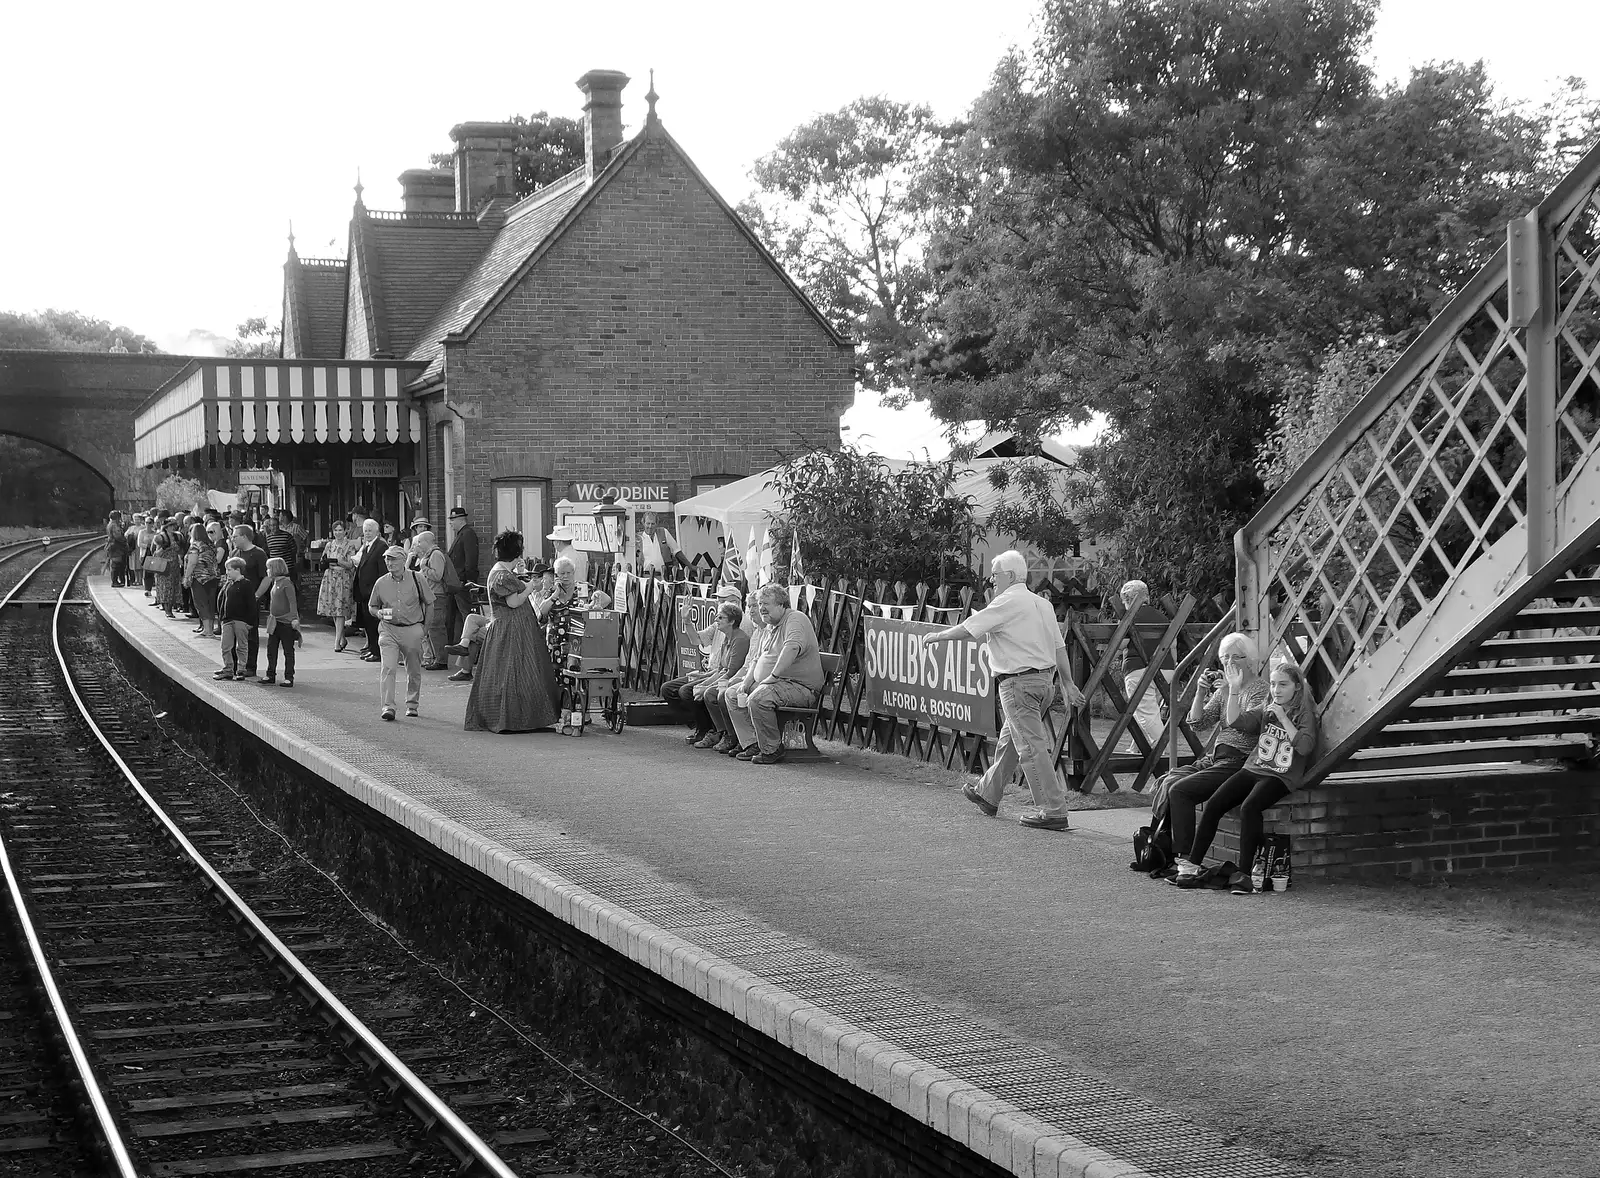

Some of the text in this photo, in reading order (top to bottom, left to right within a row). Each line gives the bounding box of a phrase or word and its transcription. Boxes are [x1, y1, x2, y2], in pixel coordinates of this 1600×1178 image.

[576, 484, 669, 500] WOODBINE
[943, 639, 990, 697] ALES
[882, 690, 972, 722] ALFORD & BOSTON
[1258, 733, 1293, 768] 98
